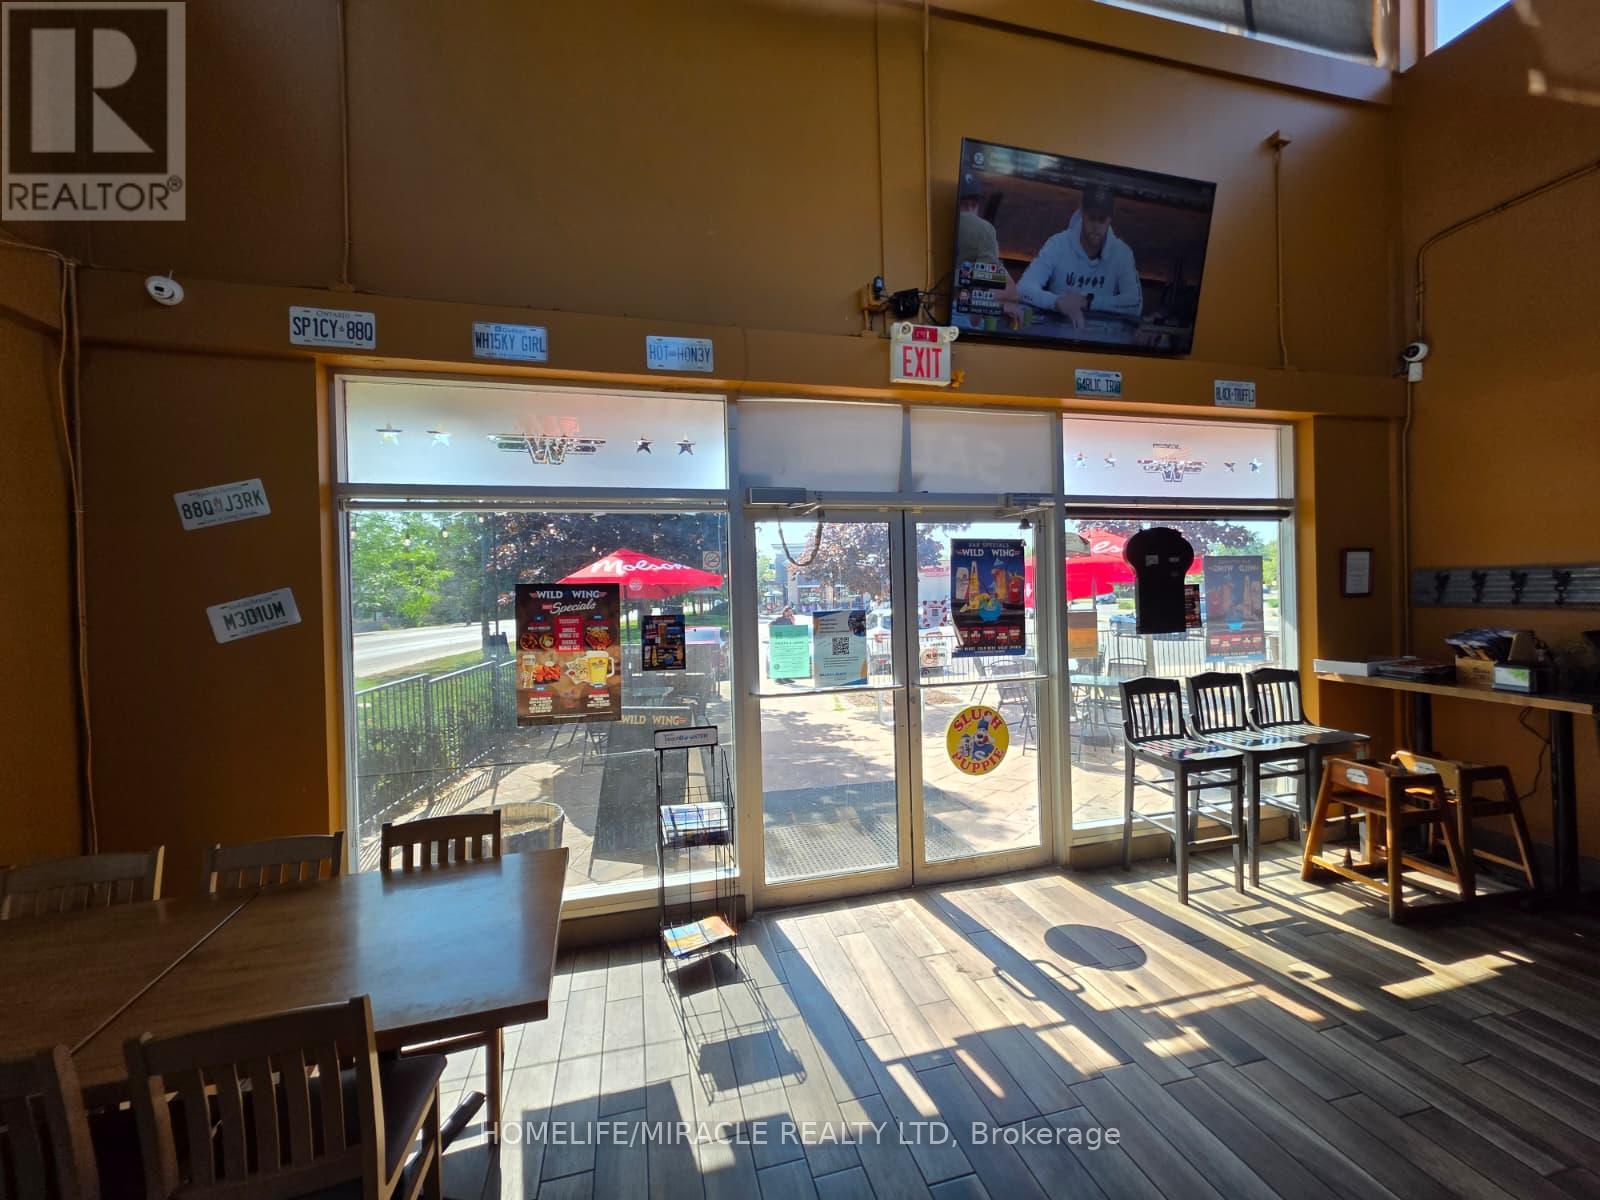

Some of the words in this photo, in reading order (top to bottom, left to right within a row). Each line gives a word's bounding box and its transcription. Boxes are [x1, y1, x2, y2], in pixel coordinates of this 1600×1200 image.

[293, 316, 338, 338] SP1CY
[346, 321, 373, 341] 88Q
[649, 344, 668, 361] HOT
[677, 346, 711, 363] HON3Y
[903, 345, 942, 378] EXIT
[181, 499, 215, 520] 88Q
[225, 489, 264, 512] J3RK
[961, 548, 984, 557] WILD
[992, 548, 1014, 557] WING
[590, 559, 691, 576] Molson
[536, 590, 564, 599] WILD
[571, 590, 600, 599] WING
[550, 598, 597, 615] Specials
[621, 714, 646, 725] WILD
[652, 715, 680, 726] WING
